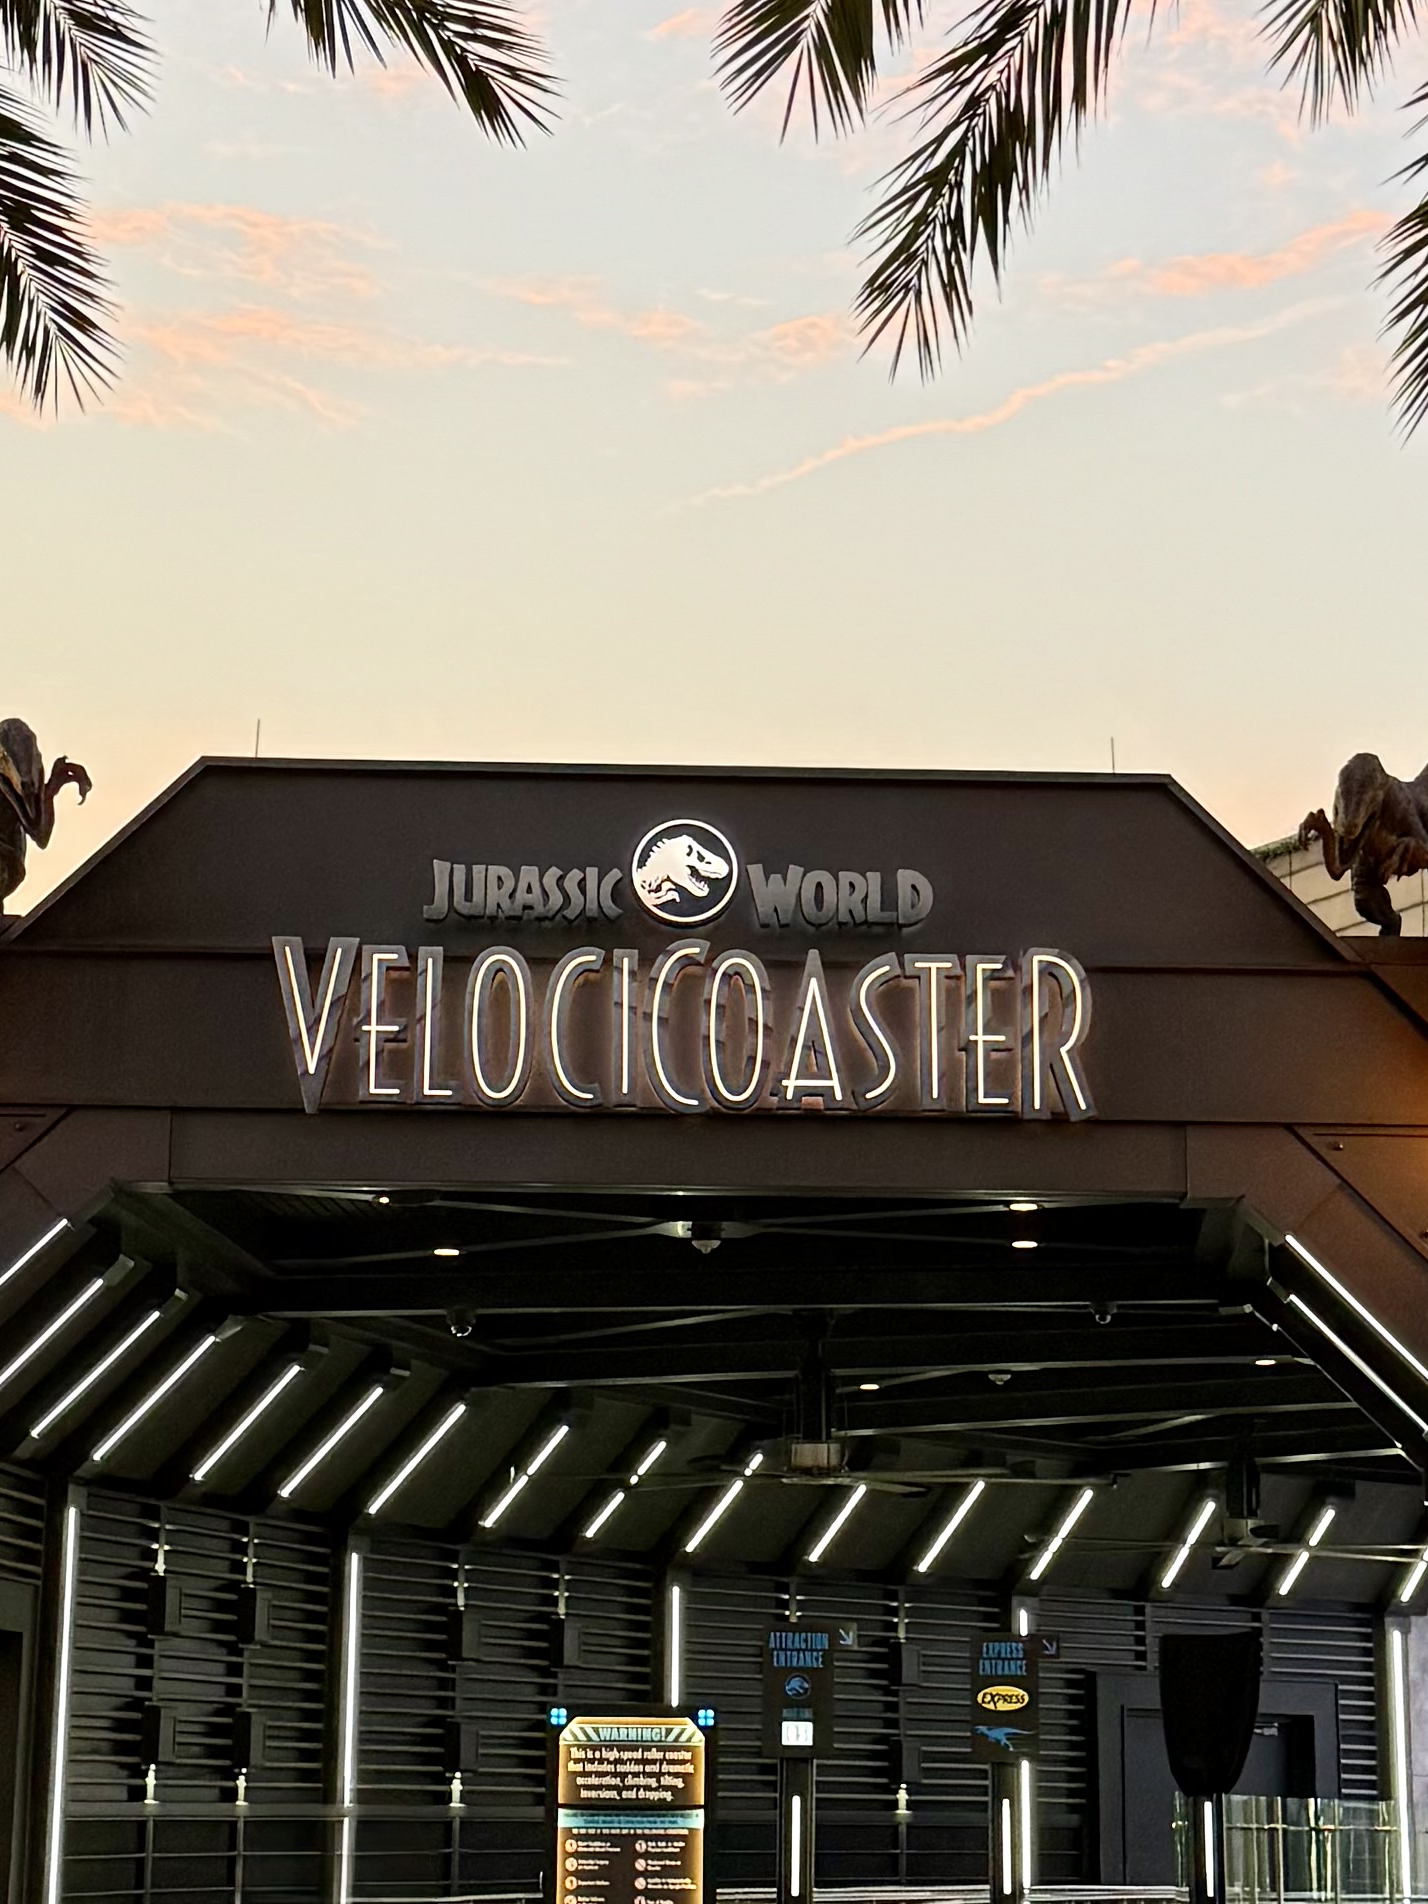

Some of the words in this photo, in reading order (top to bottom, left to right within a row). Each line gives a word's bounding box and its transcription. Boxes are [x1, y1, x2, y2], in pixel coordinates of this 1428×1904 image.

[422, 859, 625, 925] JURASSIC
[746, 863, 935, 930] WORLD
[270, 935, 1094, 1121] VELOCICOASTER
[768, 1631, 829, 1650] ATTRACTION
[982, 1641, 1024, 1658] EXPRESS
[773, 1650, 824, 1668] ENTRANCE
[979, 1659, 1027, 1676] ENTRANCE
[598, 1727, 666, 1741] WARNING!
[570, 1747, 586, 1759] This
[586, 1748, 594, 1759] is
[594, 1750, 601, 1759] a
[643, 1747, 664, 1760] roller
[567, 1760, 584, 1772] that
[584, 1760, 615, 1772] includes
[644, 1760, 660, 1773] and
[621, 1787, 637, 1799] and
